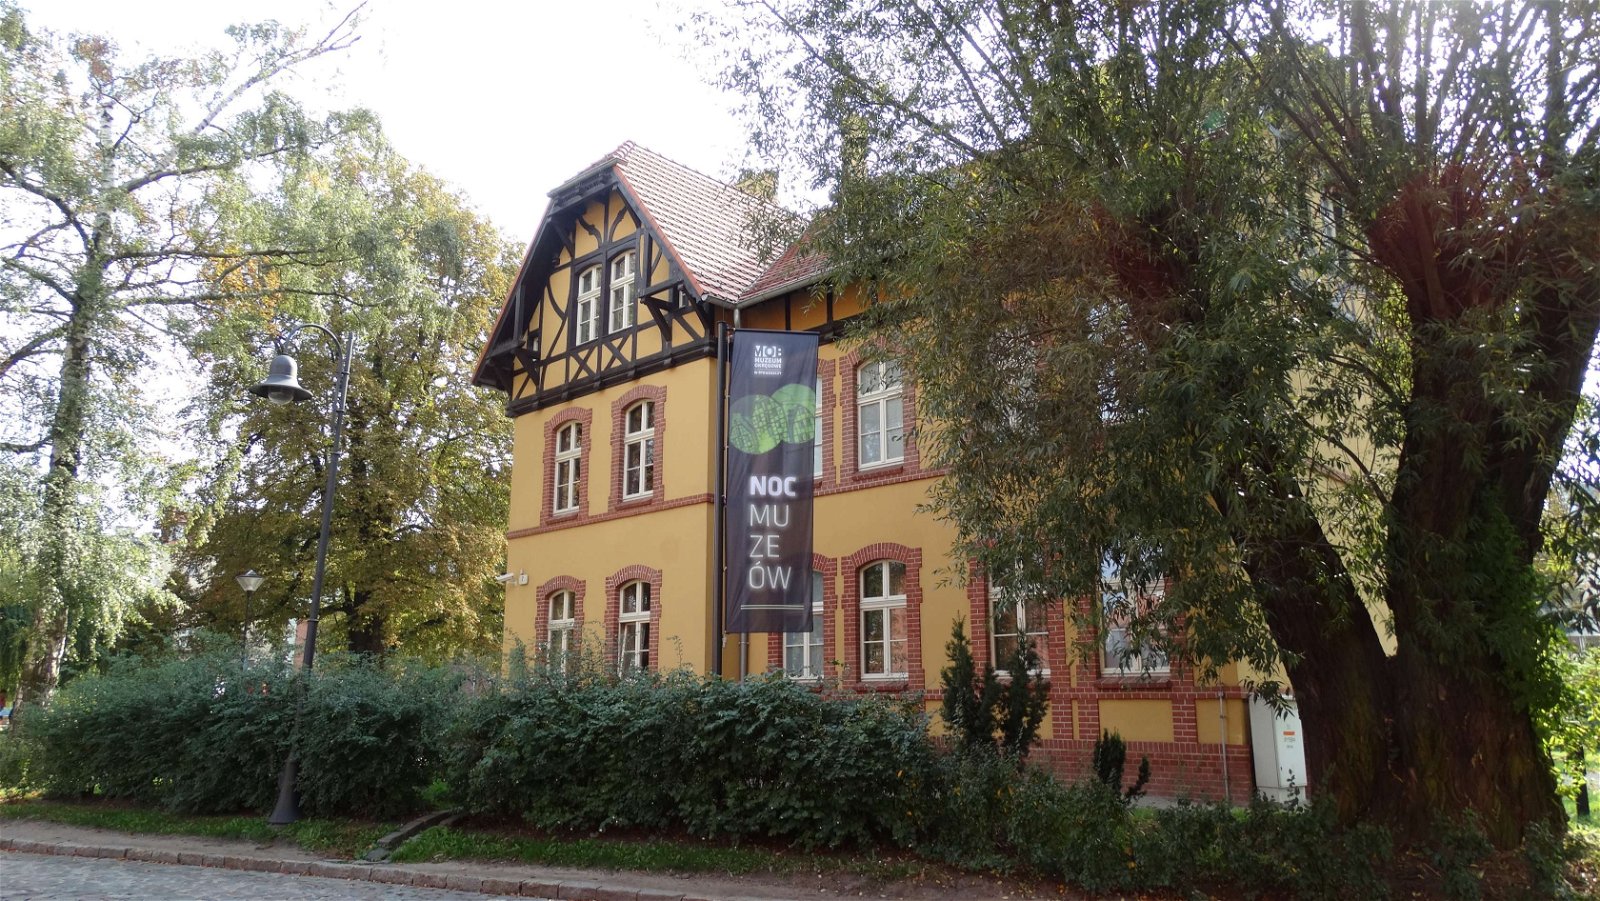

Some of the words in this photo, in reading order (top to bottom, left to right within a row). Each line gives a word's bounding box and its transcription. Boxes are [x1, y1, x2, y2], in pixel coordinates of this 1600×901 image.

[749, 475, 797, 497] NOC
[750, 504, 789, 527] MU
[749, 534, 780, 558] ZE
[749, 560, 792, 589] ÓW
